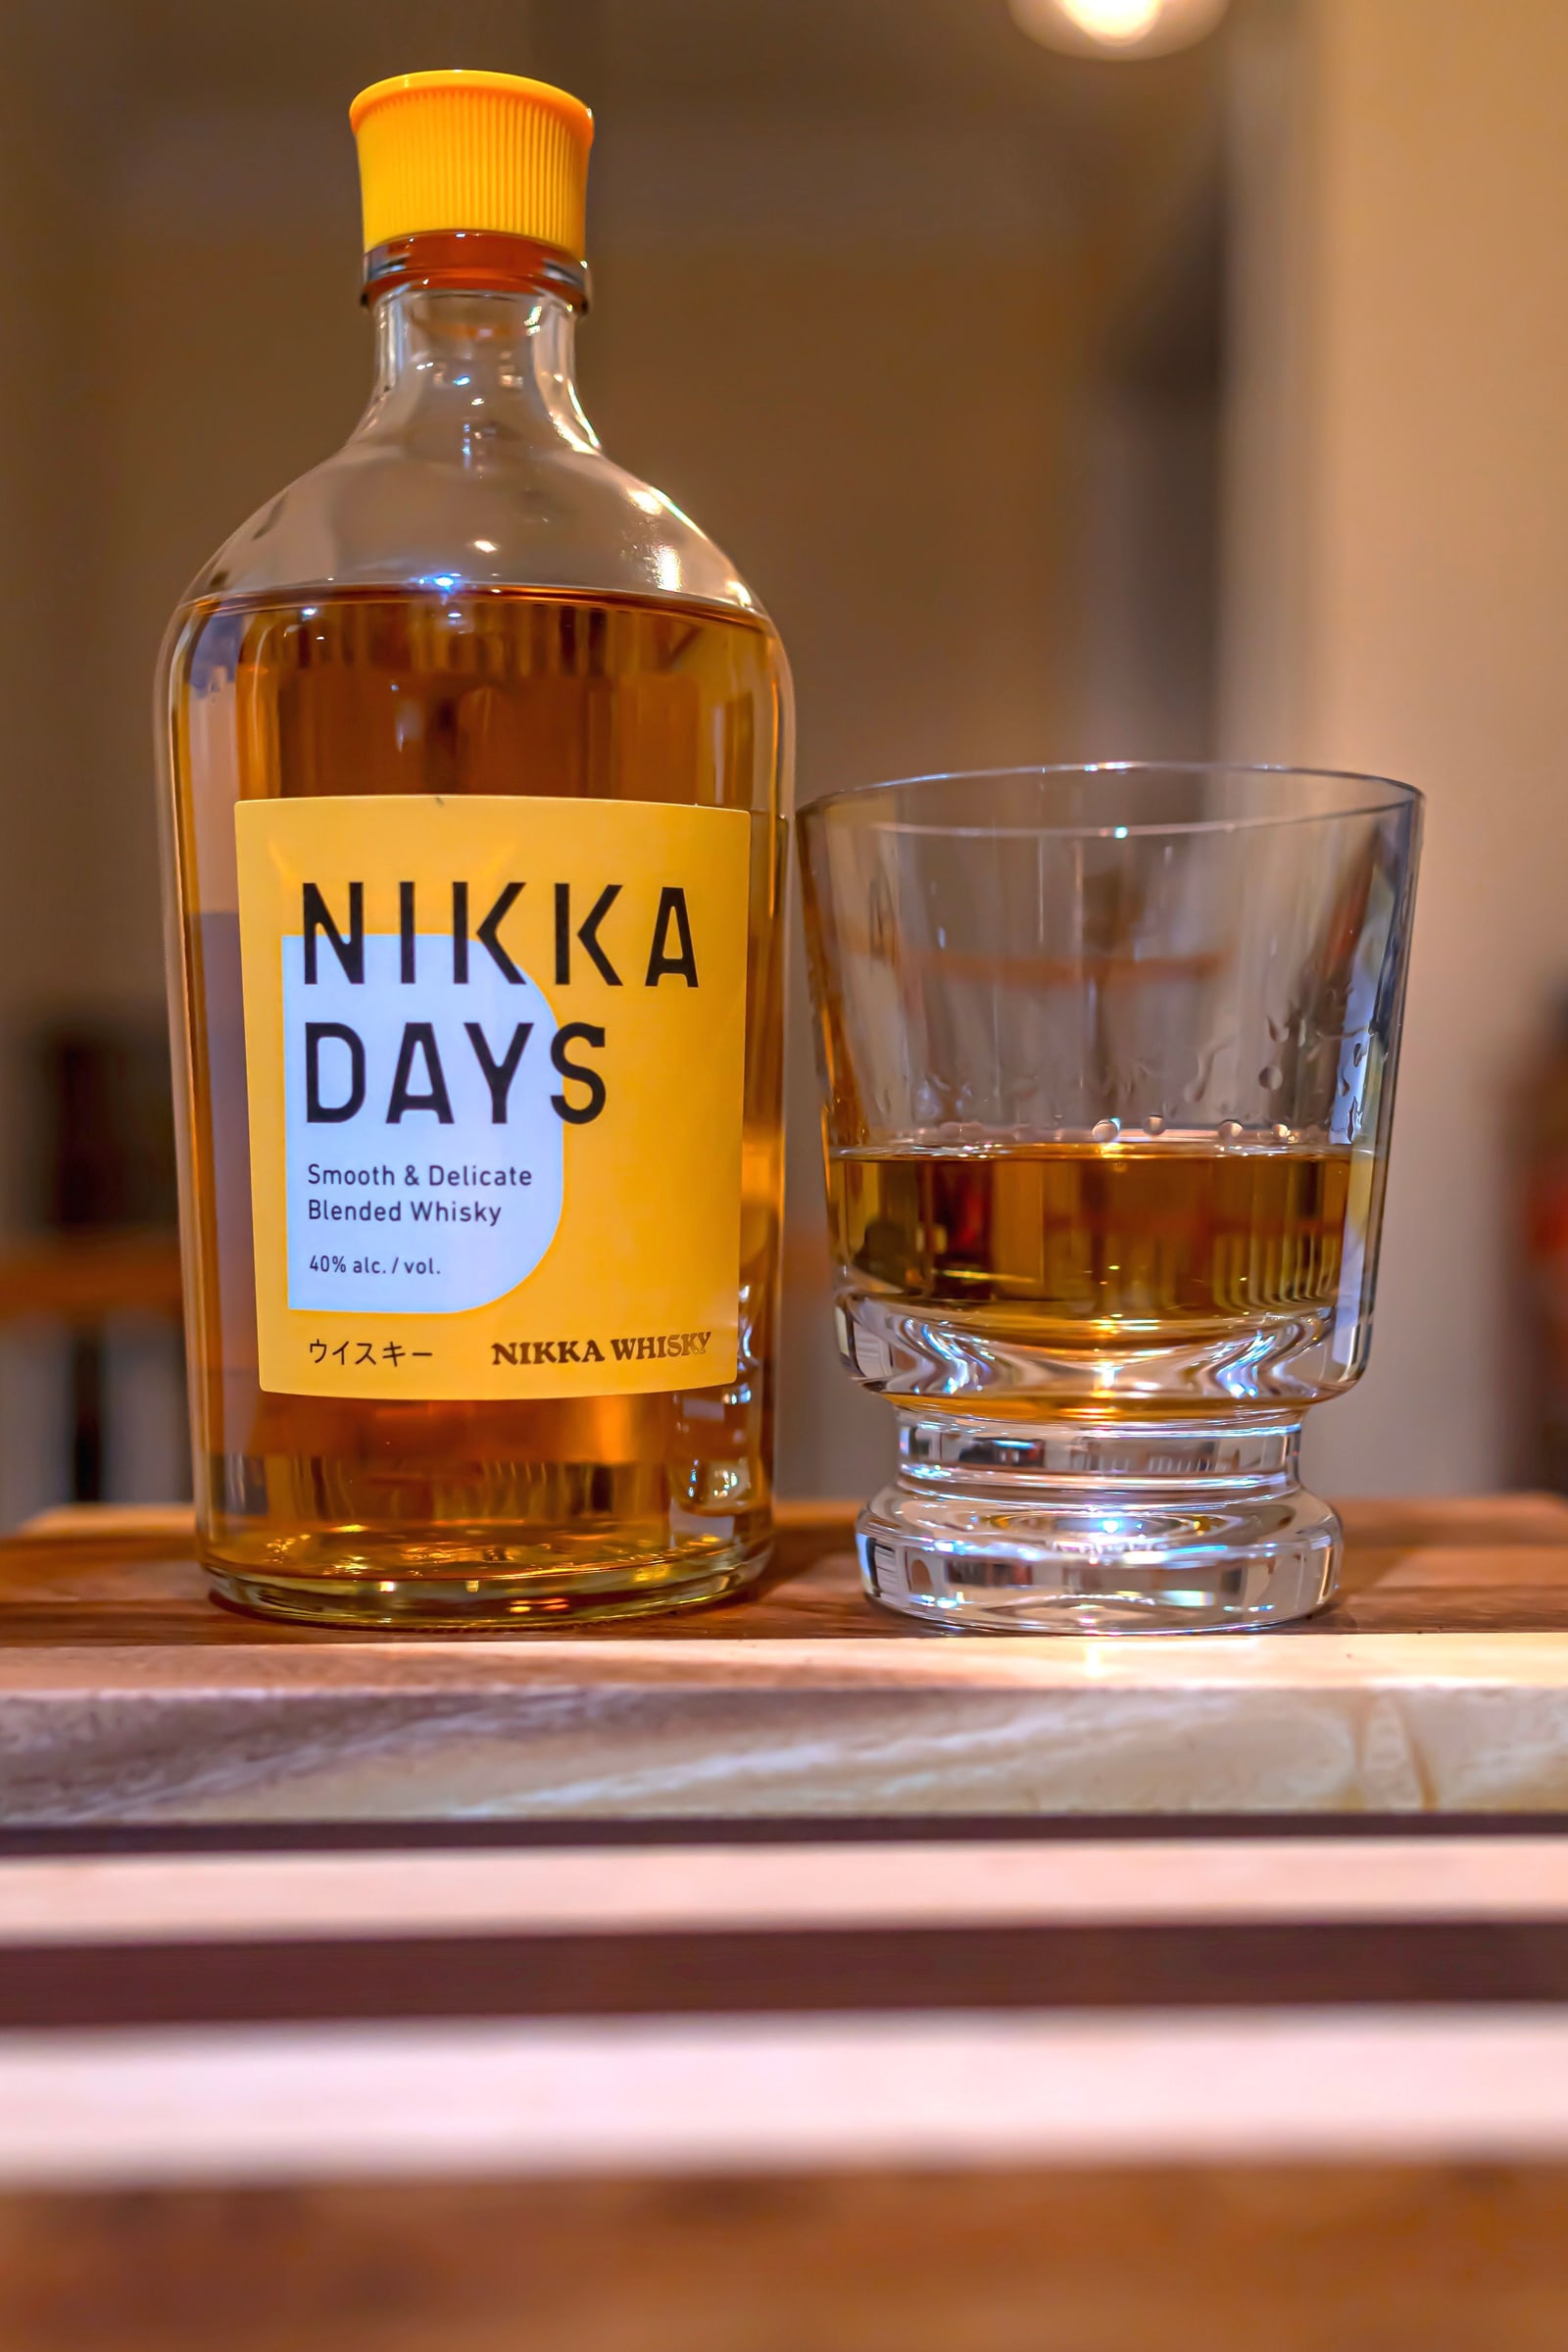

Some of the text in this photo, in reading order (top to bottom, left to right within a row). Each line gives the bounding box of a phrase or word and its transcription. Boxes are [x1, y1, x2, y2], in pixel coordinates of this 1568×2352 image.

[302, 881, 700, 988] NIKKA
[305, 1021, 607, 1125] DAYS
[308, 1163, 532, 1187] Smooth & Delicate
[308, 1200, 502, 1227] Blended Whisky
[309, 1254, 347, 1273] 40%
[309, 1338, 433, 1367] ウイスキー
[491, 1331, 712, 1365] NIKKA WHISKY
